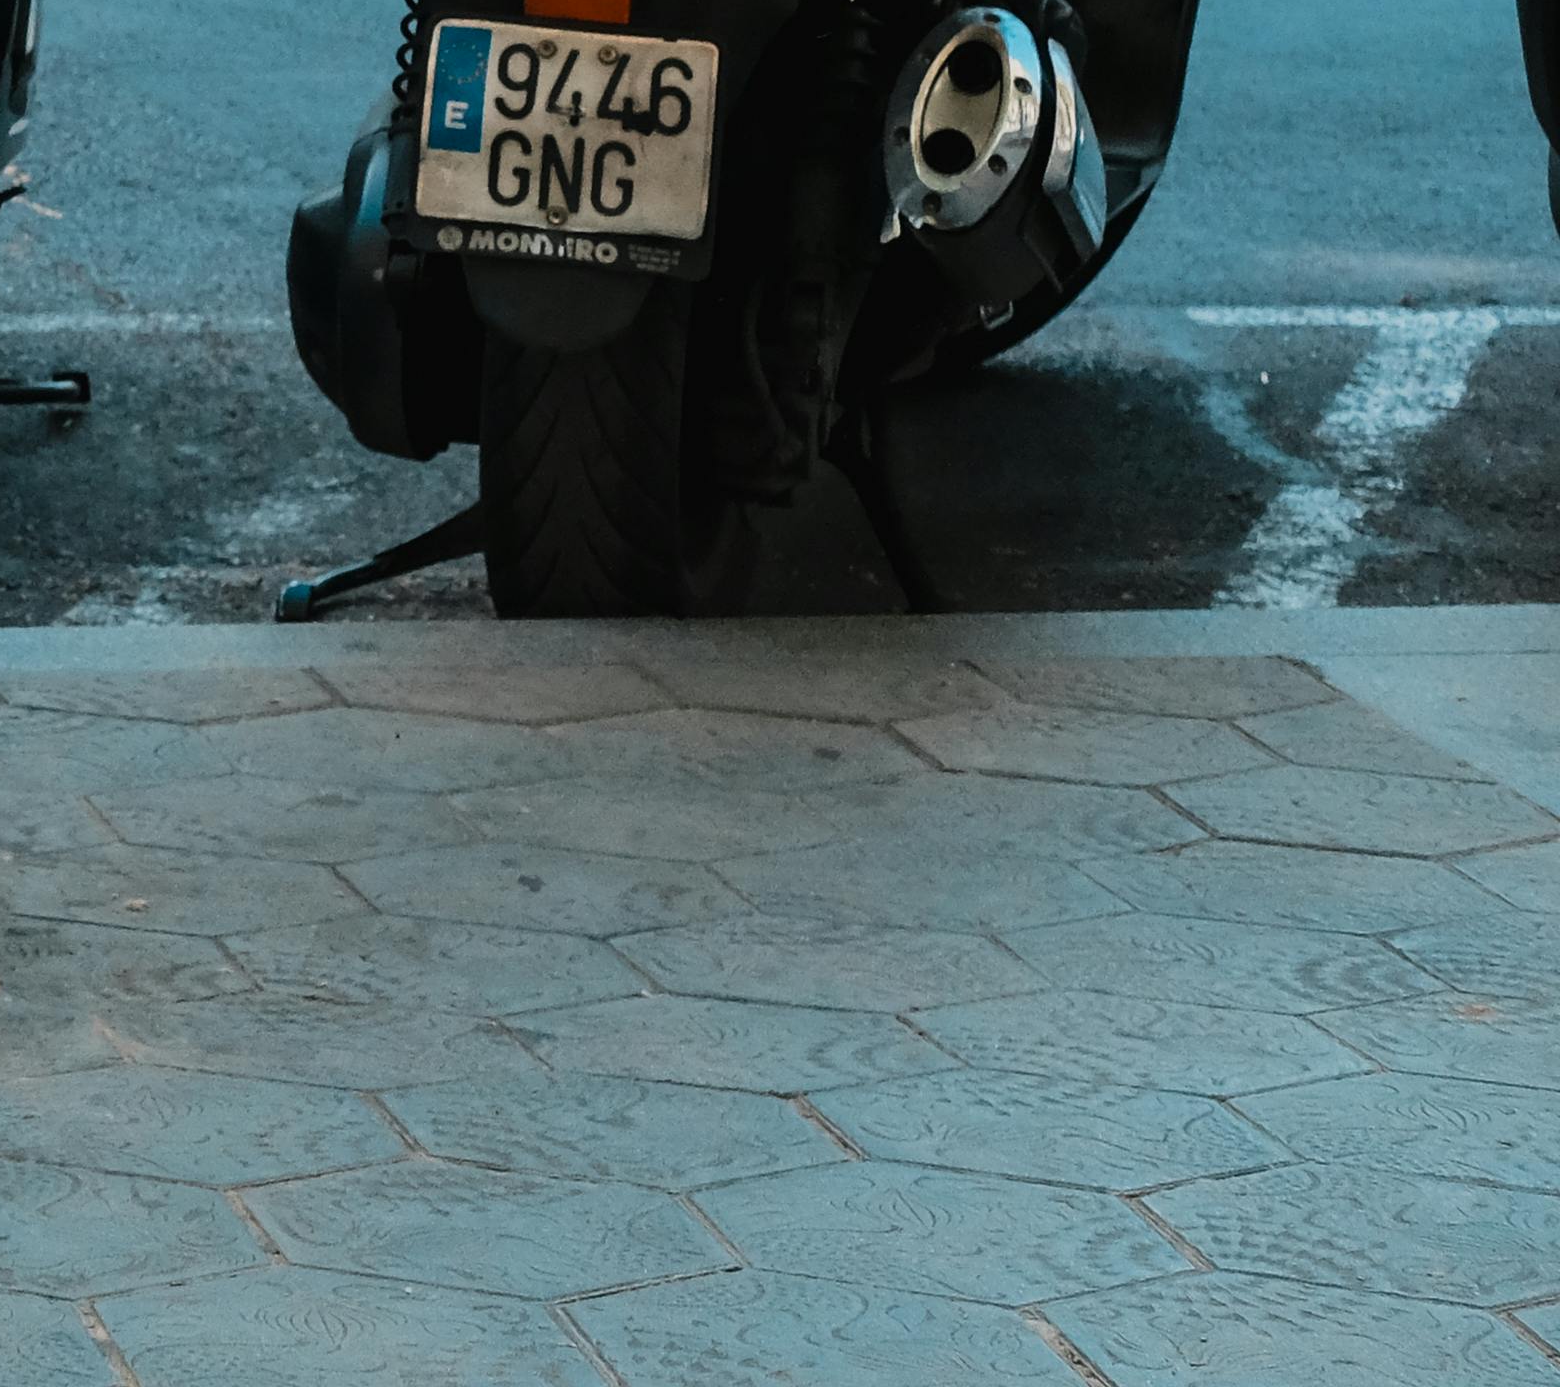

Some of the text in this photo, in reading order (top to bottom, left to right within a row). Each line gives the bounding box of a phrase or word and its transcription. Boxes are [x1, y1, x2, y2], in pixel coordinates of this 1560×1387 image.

[444, 100, 469, 129] E
[494, 42, 694, 137] 9446
[487, 129, 637, 217] GNG
